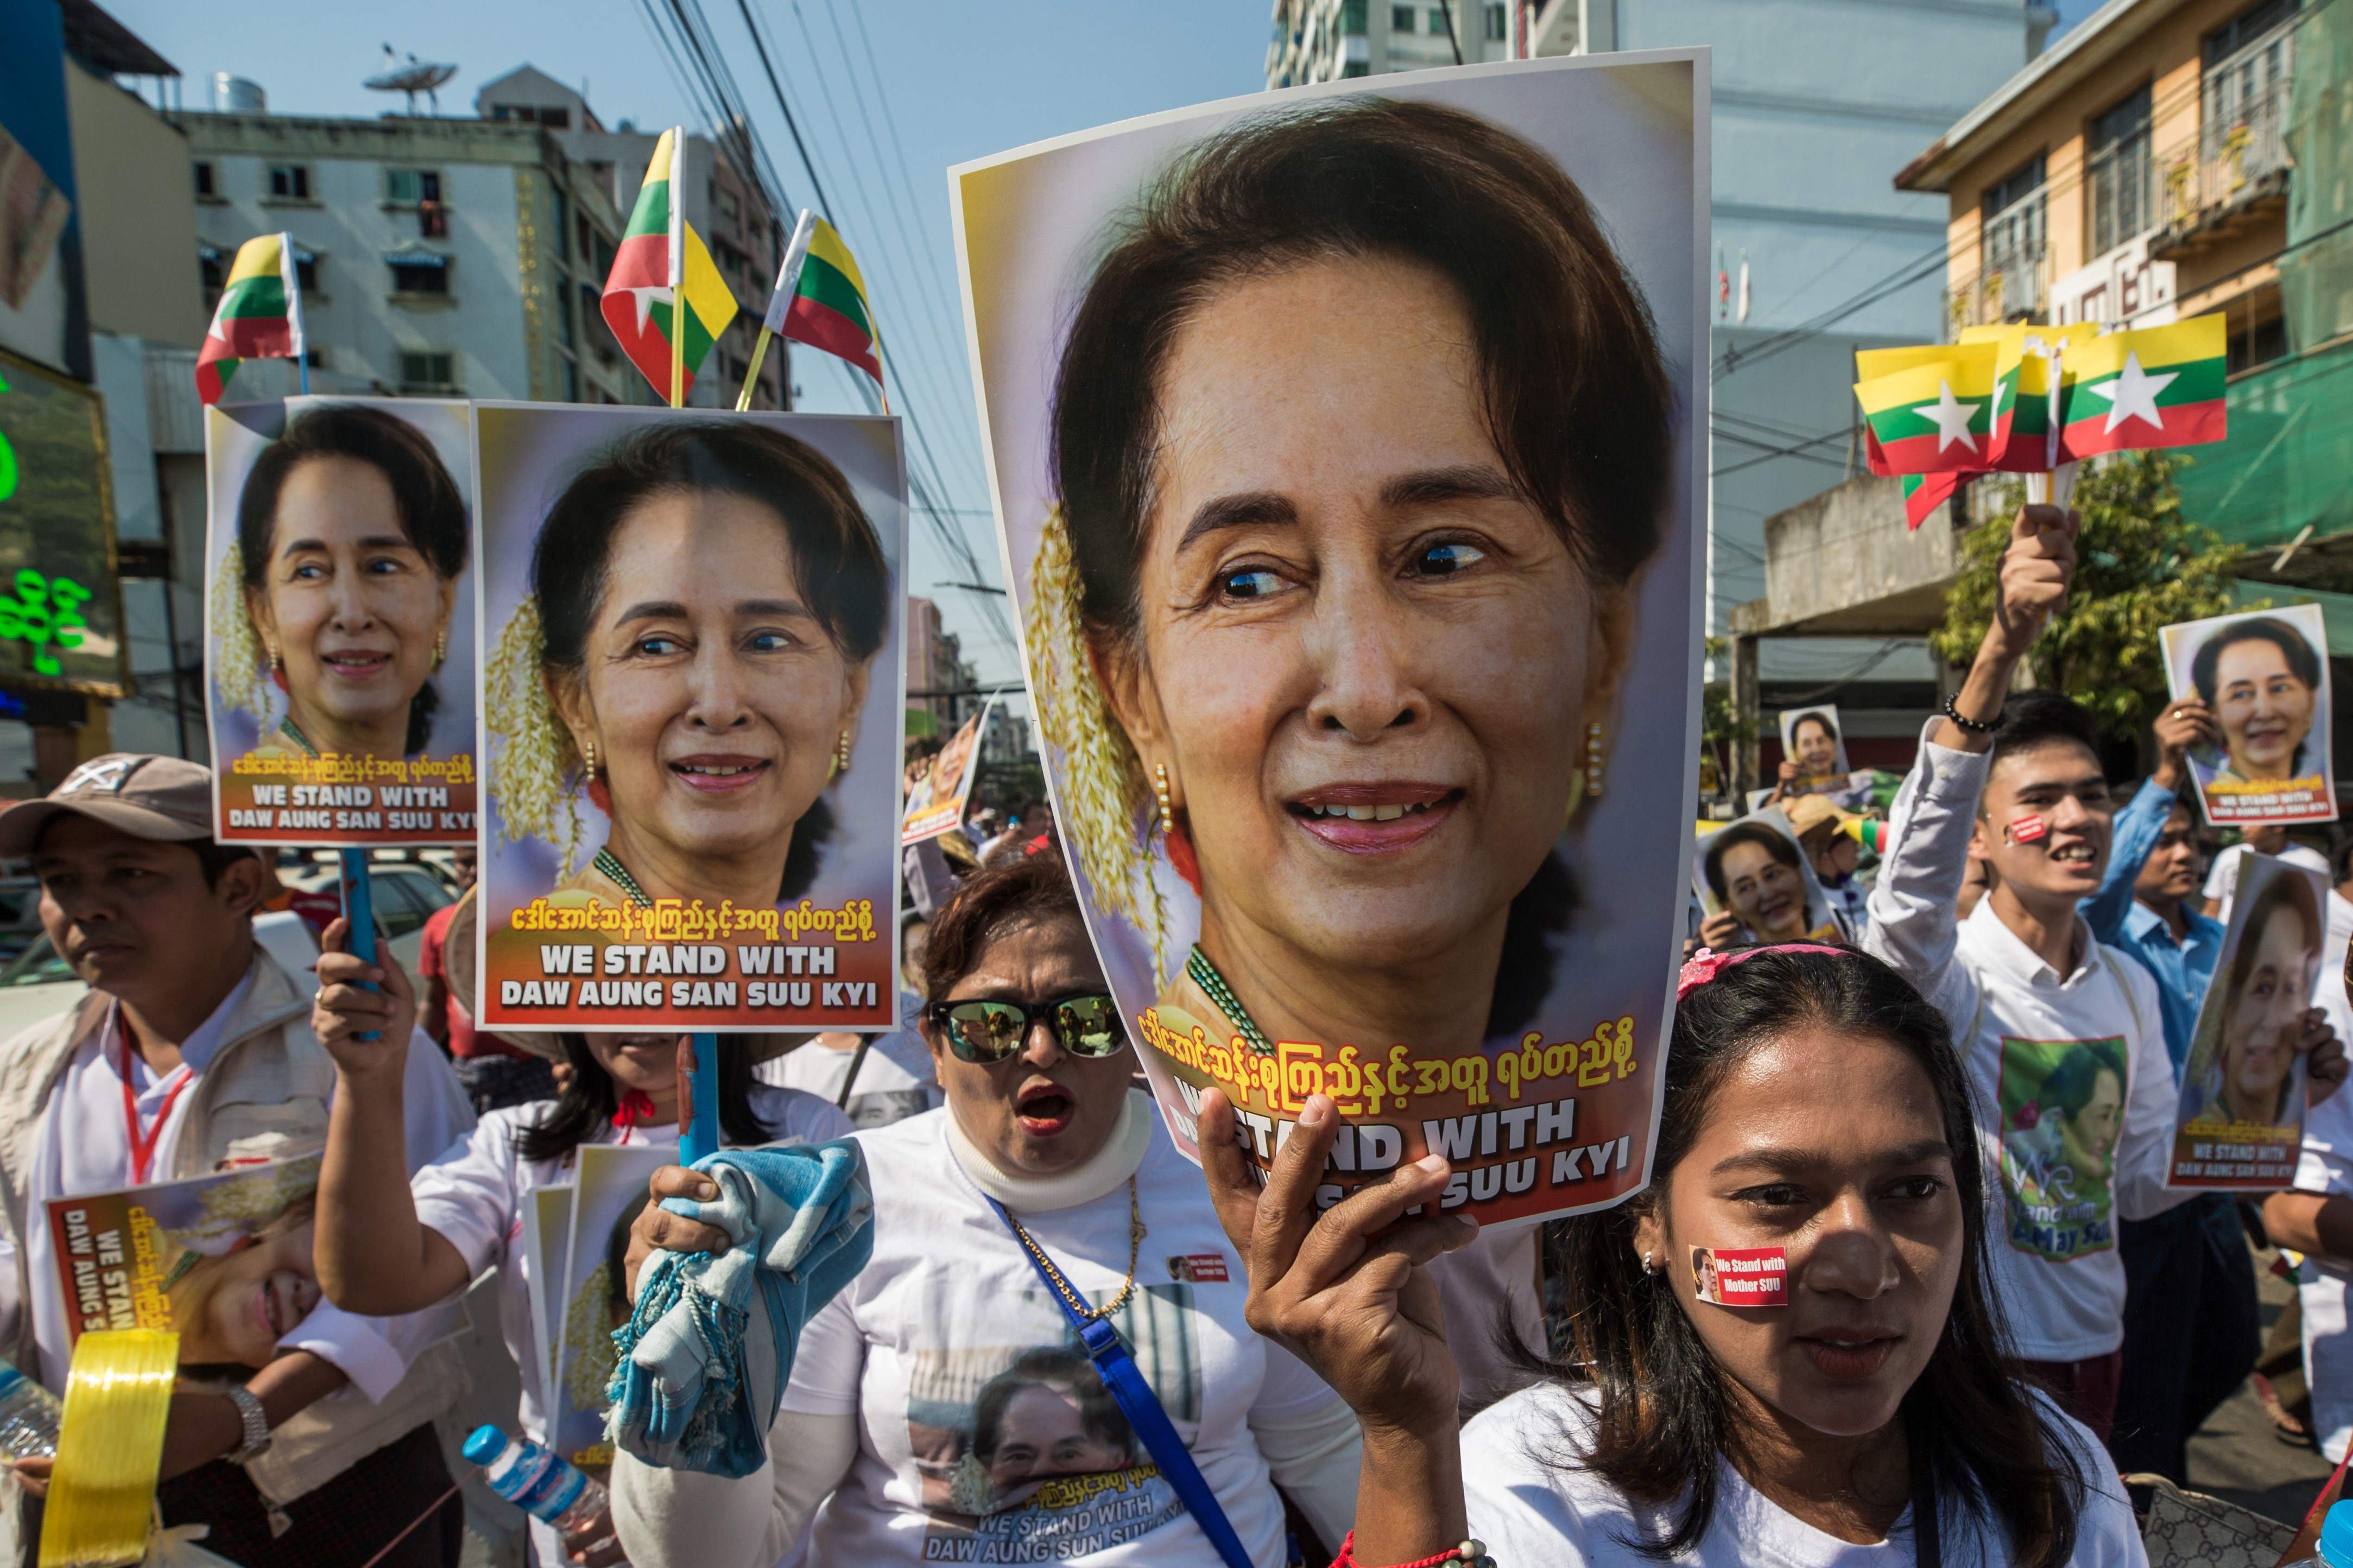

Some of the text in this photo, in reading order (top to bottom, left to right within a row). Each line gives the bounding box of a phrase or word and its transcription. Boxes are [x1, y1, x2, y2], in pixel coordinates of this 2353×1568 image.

[252, 784, 449, 808] WE STAND WITH
[229, 809, 273, 828] DAW
[278, 811, 331, 828] AUNG
[337, 812, 381, 829] SAN
[388, 812, 433, 829] SUU
[541, 945, 834, 975] WE STAND WITH
[502, 980, 877, 1007] DAW AUNG SAN SUU KYI
[1173, 1075, 1203, 1116] W
[1423, 1098, 1574, 1160] WITH
[2193, 1142, 2213, 1160] WE
[1441, 1157, 1536, 1209] SUU
[1552, 1135, 1629, 1184] KYI
[65, 1209, 93, 1254] DAW
[96, 1229, 135, 1330] WE STAN
[1716, 1257, 1785, 1273] We Stand with
[73, 1260, 103, 1314] AUNG
[1724, 1278, 1781, 1292] Mother SUU
[977, 1493, 1153, 1538] WE STAND WITH
[924, 1537, 977, 1561] DAW
[982, 1539, 1049, 1563] AUNG
[1055, 1534, 1104, 1559] SUN
